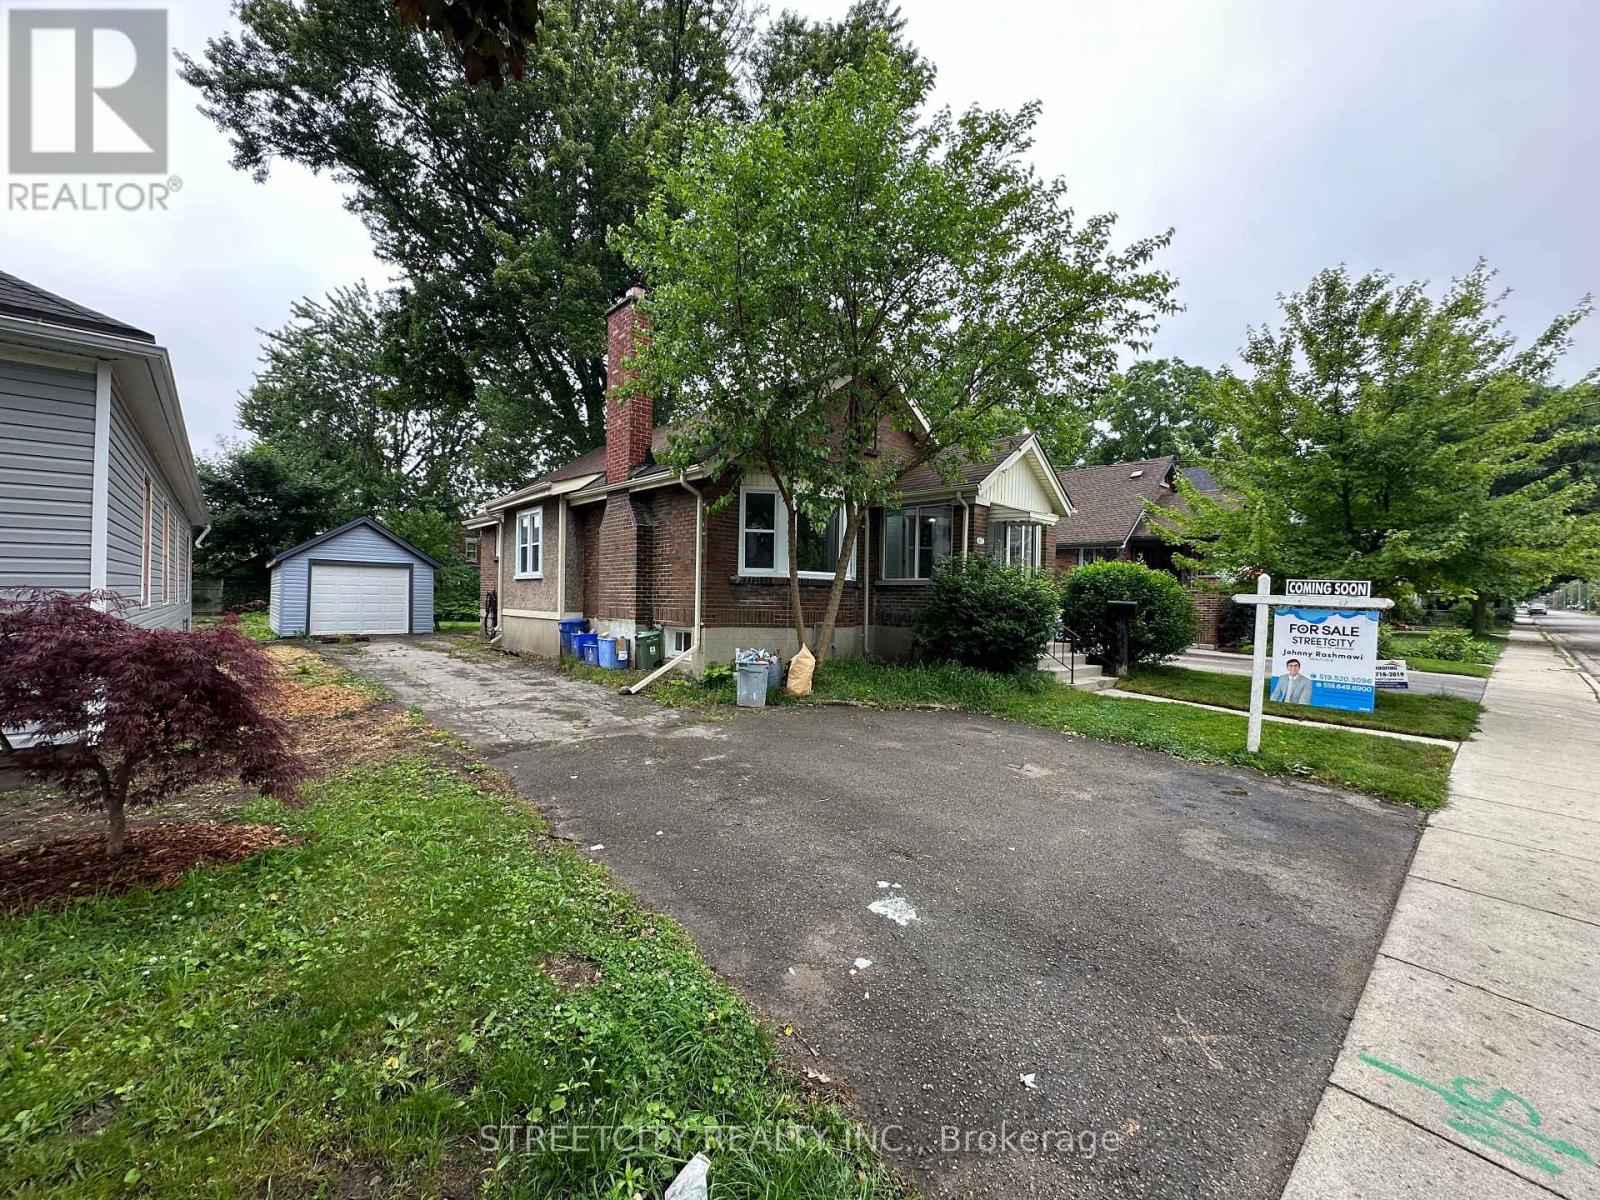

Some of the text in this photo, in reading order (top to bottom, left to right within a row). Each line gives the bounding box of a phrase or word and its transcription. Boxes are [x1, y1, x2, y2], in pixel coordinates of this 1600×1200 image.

[1289, 582, 1367, 596] COMING SOON
[1289, 624, 1360, 637] FOR SALE
[1292, 636, 1355, 648] STREETCITY
[1282, 649, 1313, 658] Johnny
[1315, 651, 1363, 661] Rashmawi
